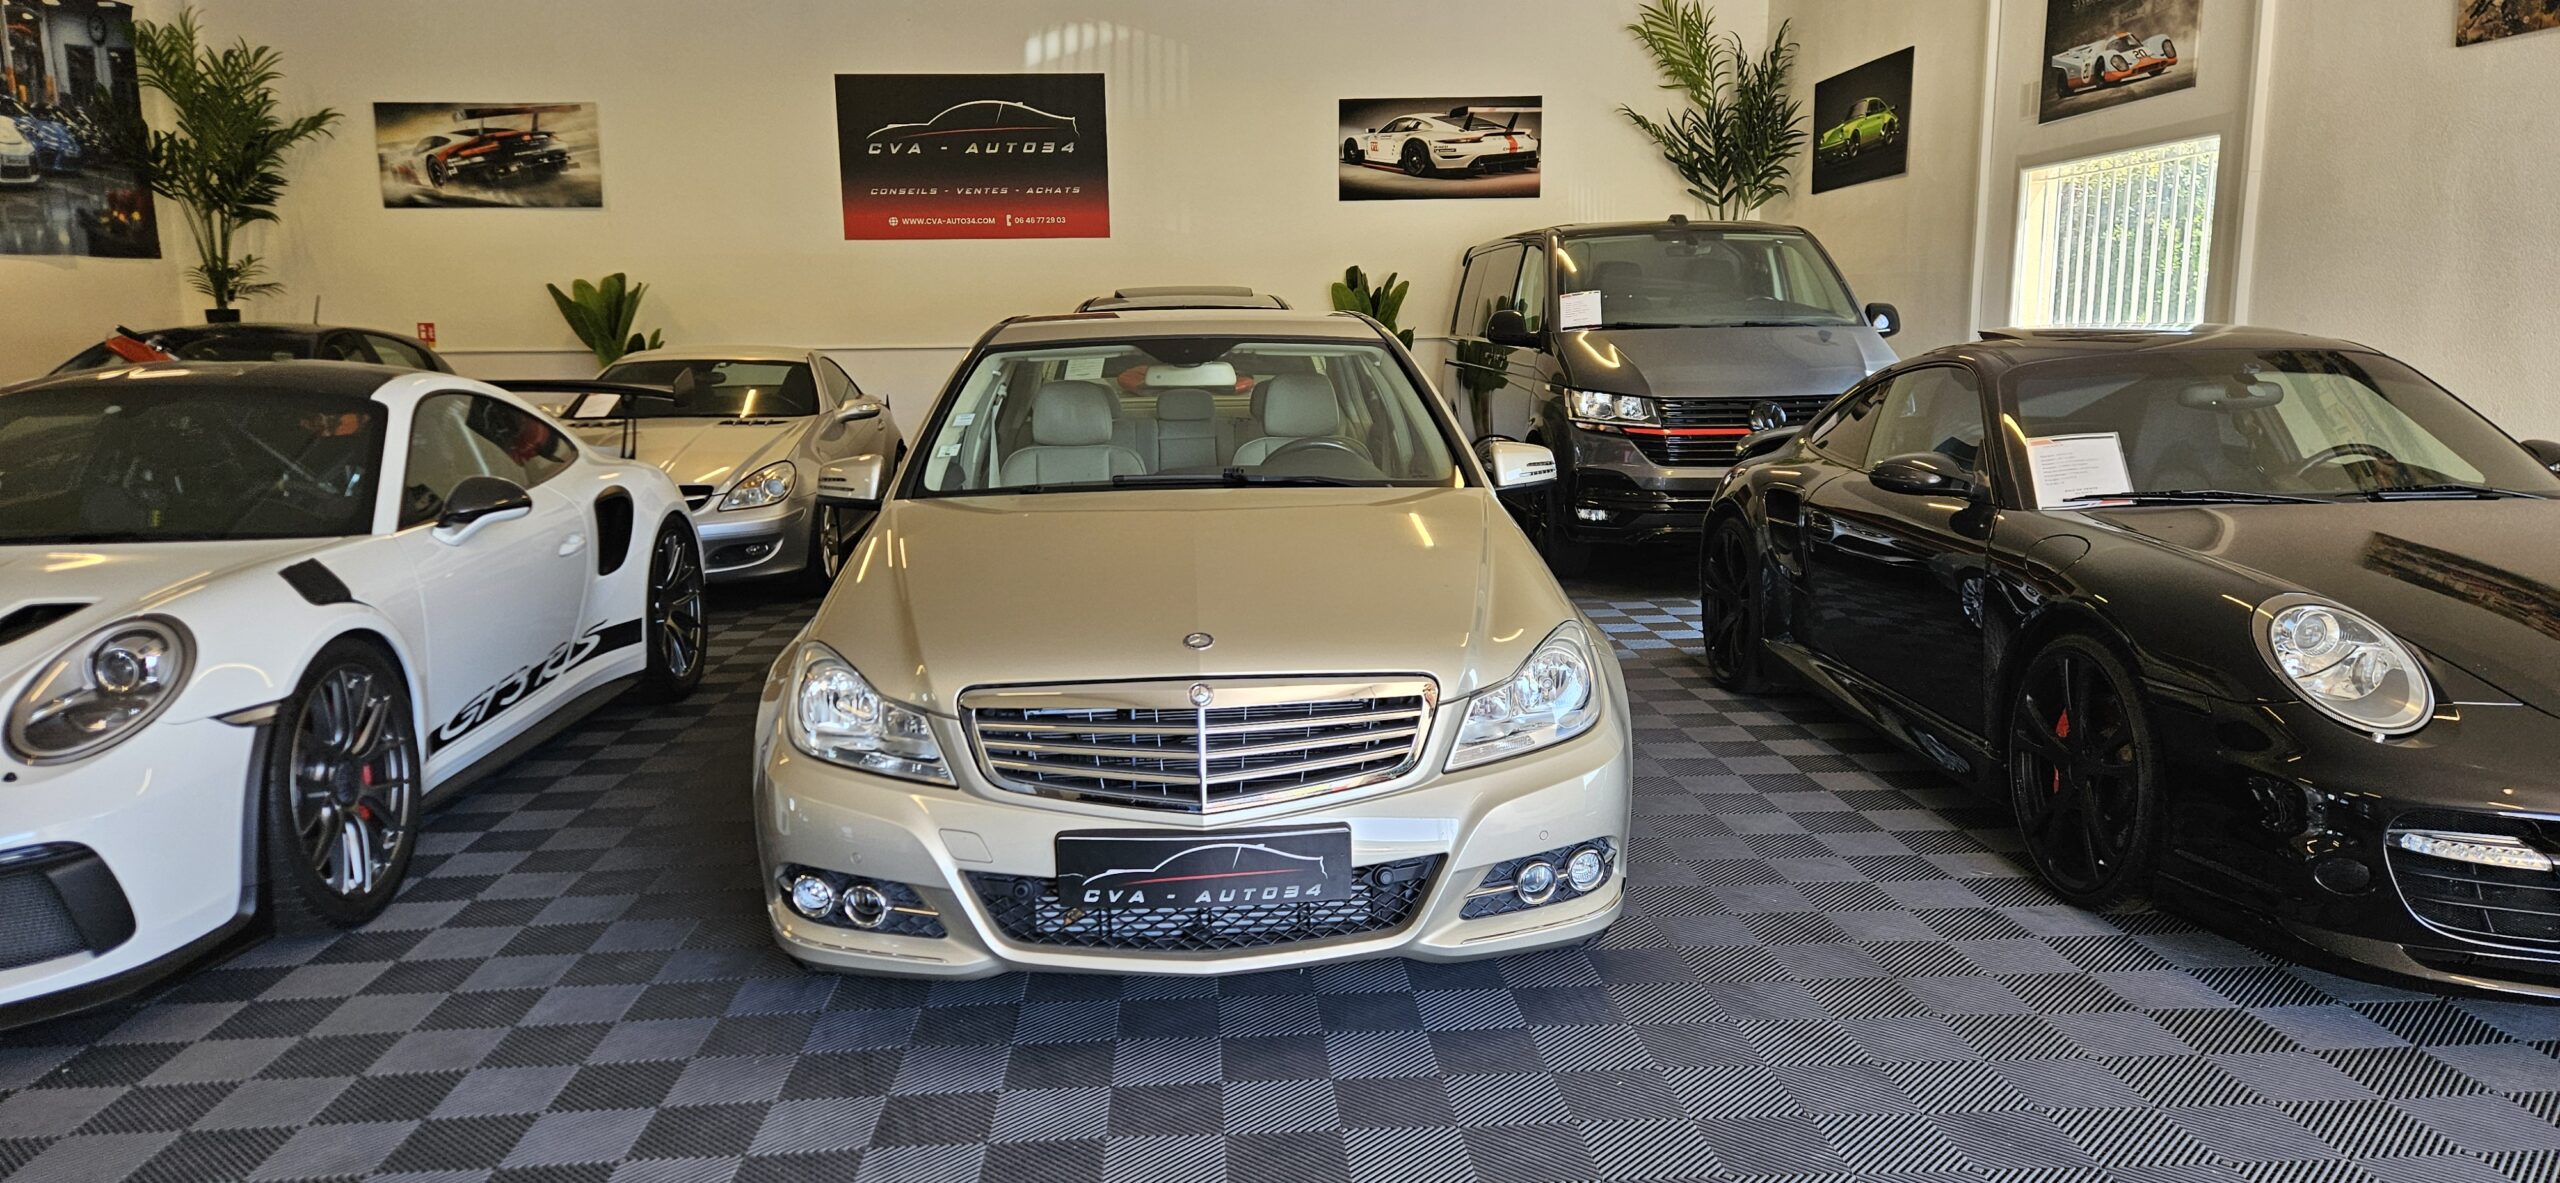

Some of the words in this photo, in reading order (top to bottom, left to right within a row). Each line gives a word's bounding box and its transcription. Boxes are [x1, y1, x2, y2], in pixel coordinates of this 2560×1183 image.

[867, 142, 922, 154] CVA
[964, 141, 1075, 154] AUTO34
[870, 187, 938, 196] CONSEILS
[956, 187, 1009, 195] VENTES
[1026, 186, 1081, 194] ACHATS
[901, 217, 996, 225] WWW.CVA-AUTO34.COM
[1014, 216, 1025, 224] 06
[1036, 216, 1045, 224] 77
[1056, 216, 1066, 224] 03
[1083, 889, 1146, 903] CVA
[1195, 883, 1322, 903] AUTO34
